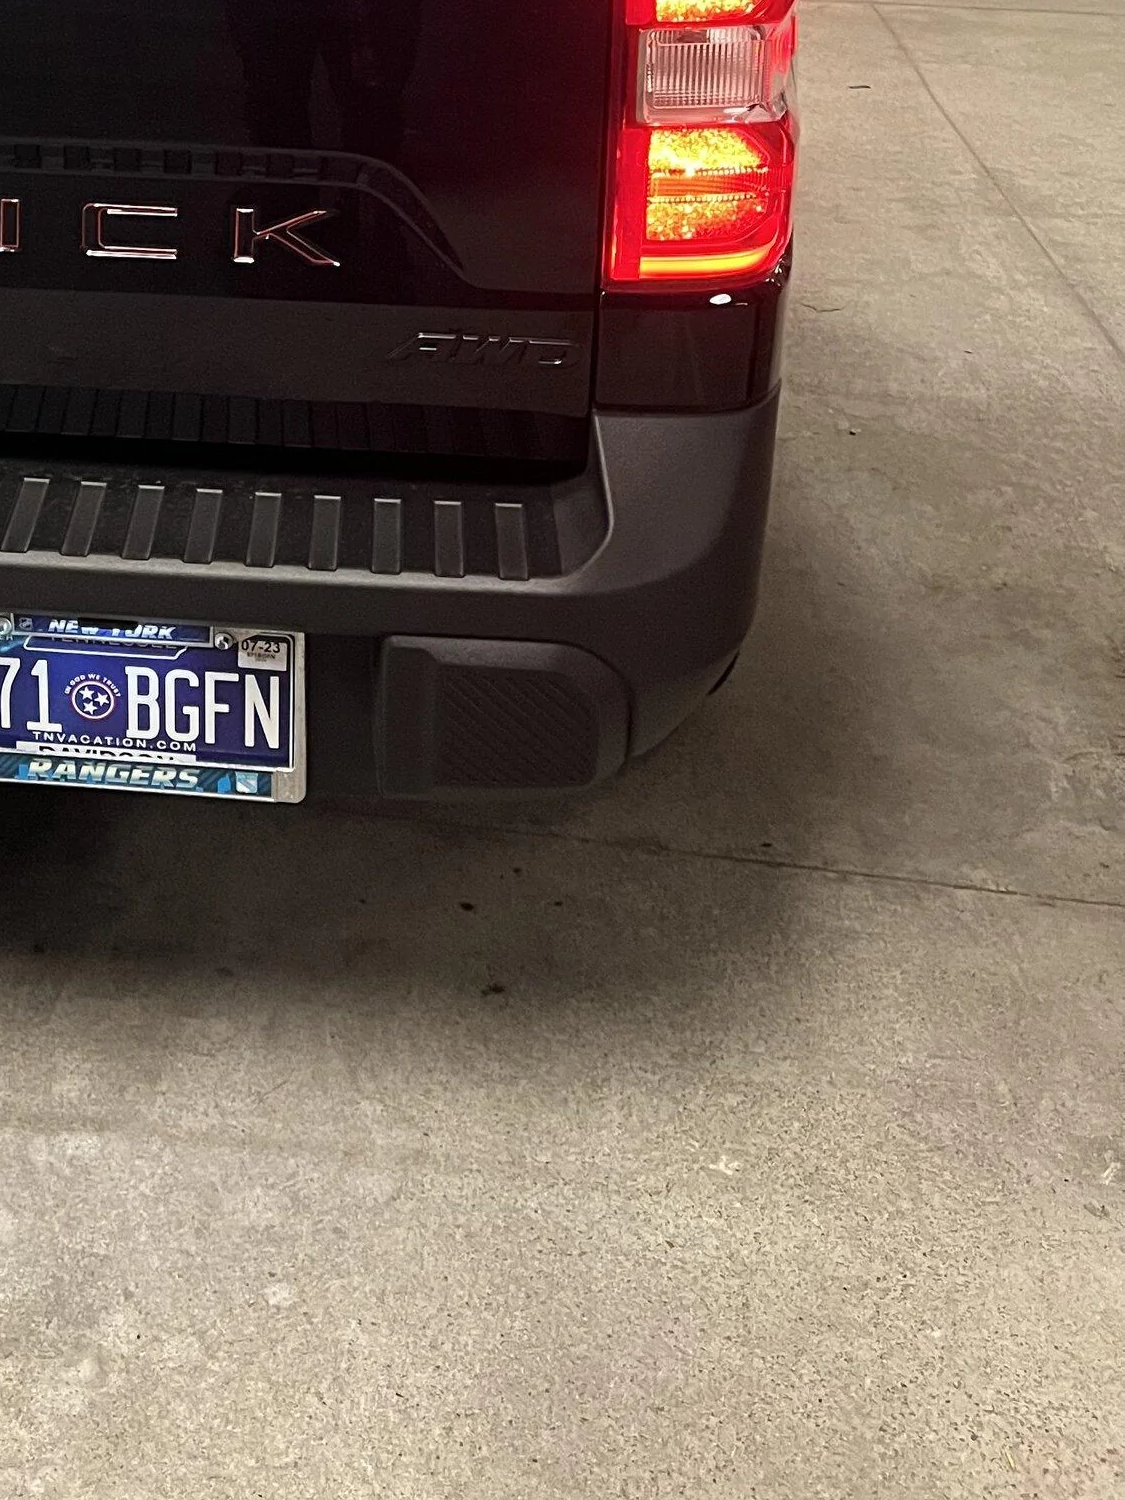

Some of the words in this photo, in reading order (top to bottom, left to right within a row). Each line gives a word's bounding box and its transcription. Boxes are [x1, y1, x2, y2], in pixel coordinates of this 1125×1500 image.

[241, 640, 281, 654] 07-23
[87, 673, 101, 681] WE
[102, 676, 122, 697] TRUST
[125, 665, 280, 750] BGFN
[32, 731, 197, 752] TNVACATION.COM
[27, 758, 201, 789] RANGERS
